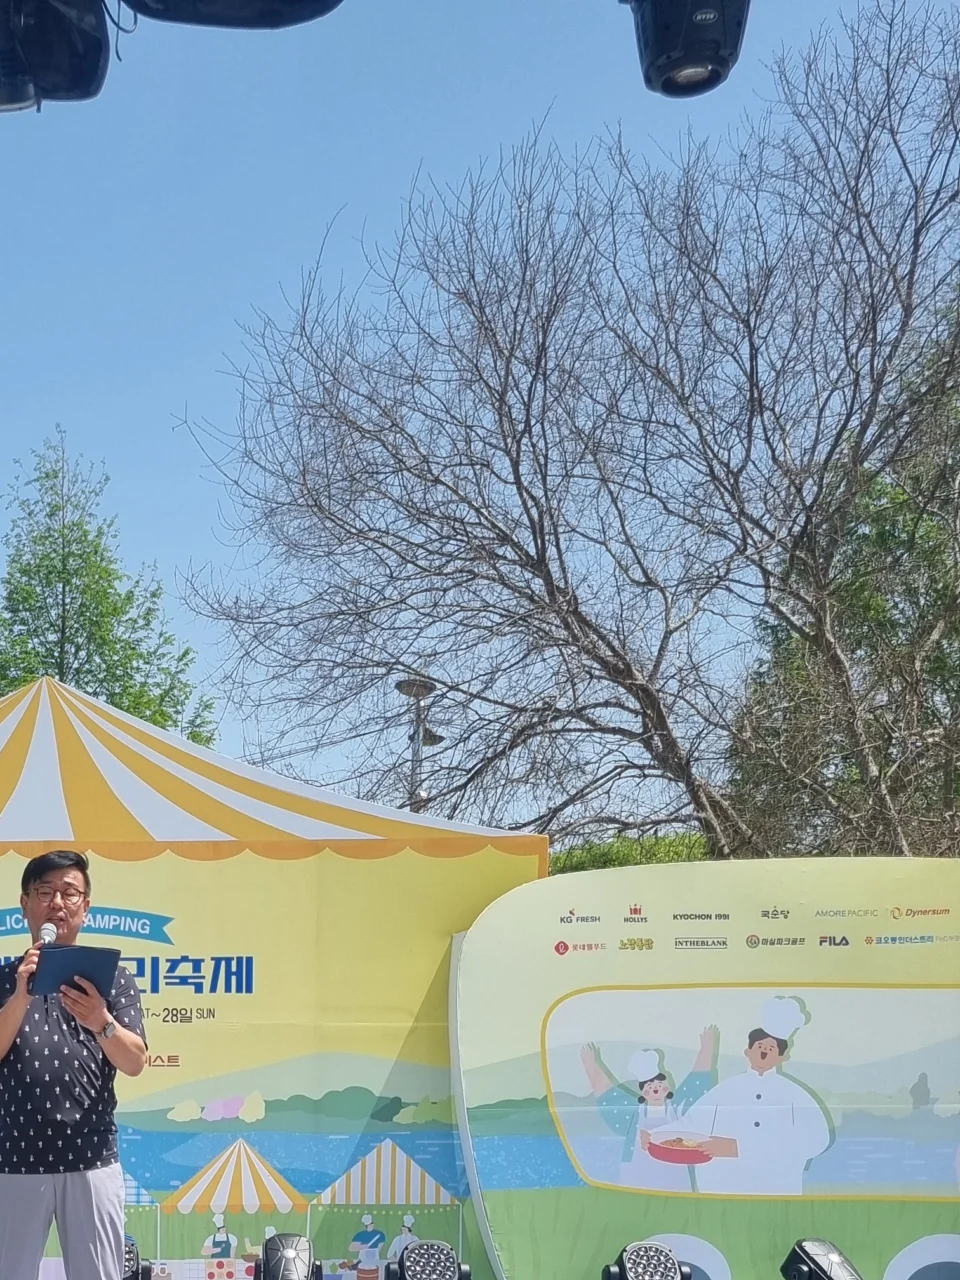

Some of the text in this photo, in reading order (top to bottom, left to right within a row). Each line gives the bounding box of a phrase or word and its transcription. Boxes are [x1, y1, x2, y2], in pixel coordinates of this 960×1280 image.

[760, 906, 790, 919] 국순당
[905, 907, 950, 918] Dynersum
[83, 916, 151, 934] AMPING
[560, 915, 601, 924] KG FRESH
[819, 936, 850, 946] FILA
[874, 935, 934, 945] 코오롱인더스트리
[195, 1008, 216, 1019] SUN
